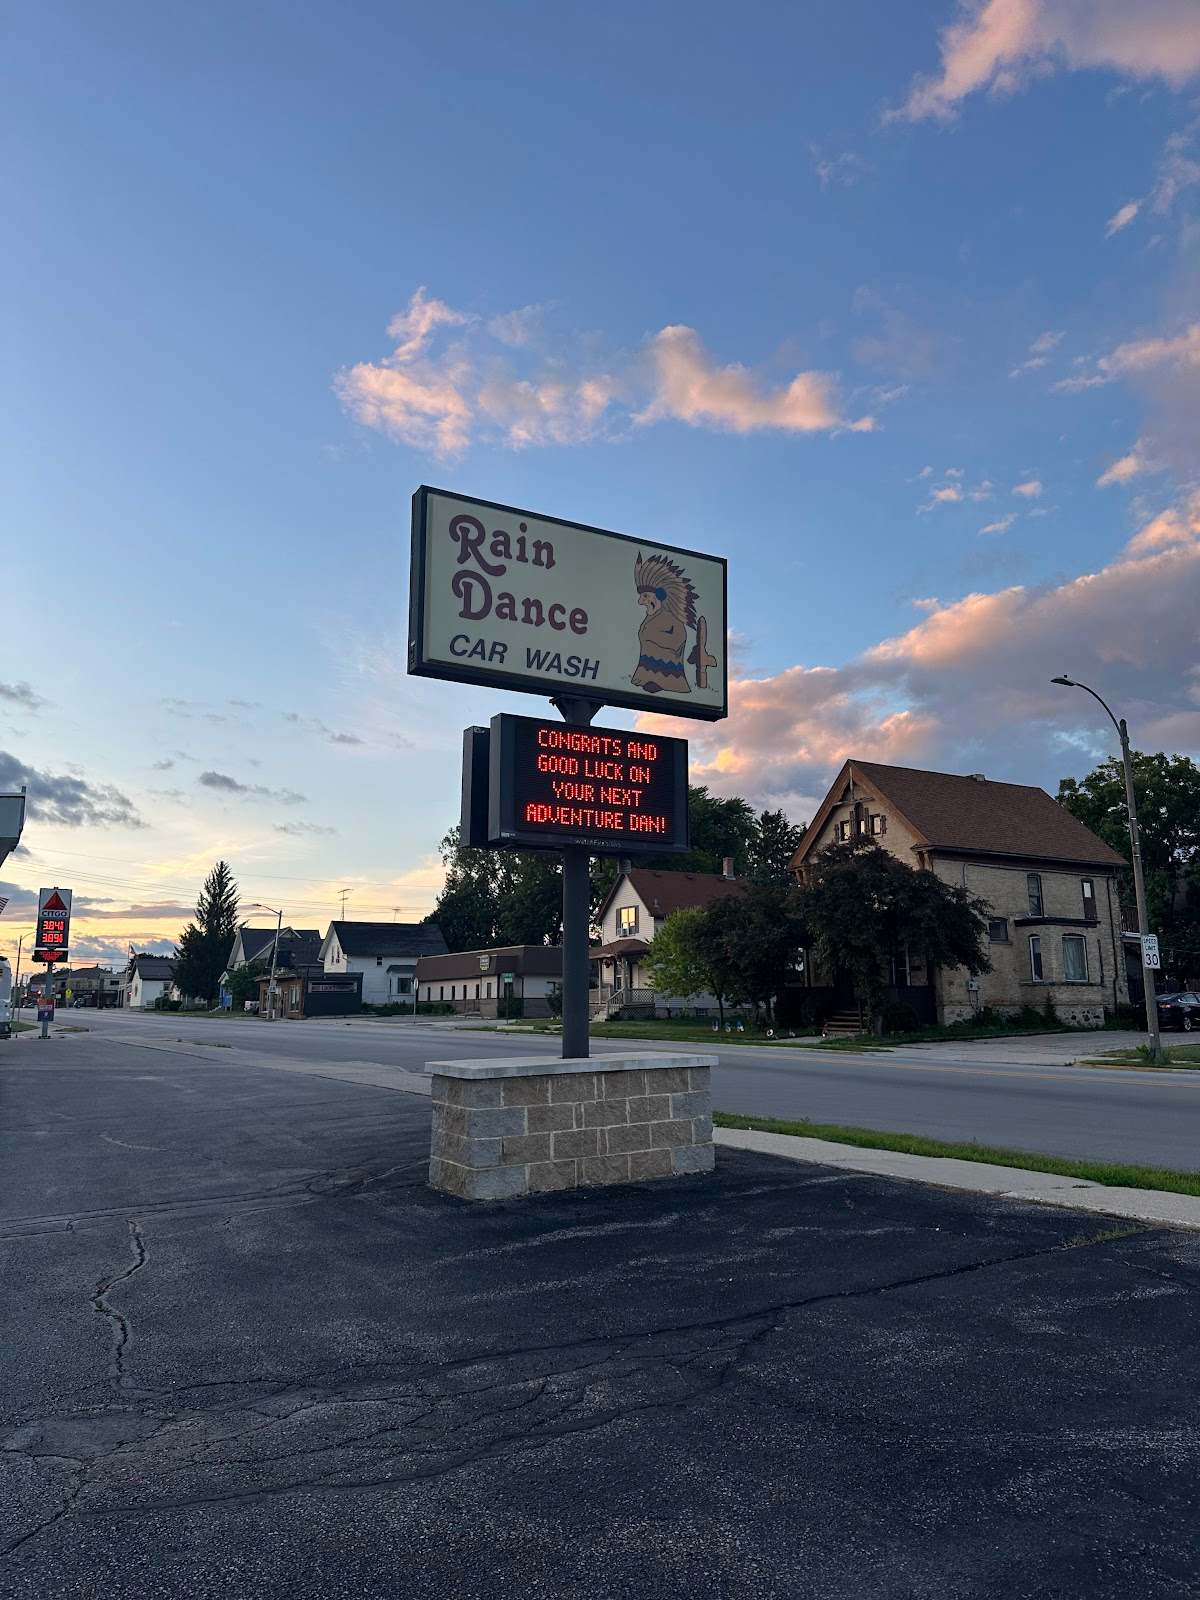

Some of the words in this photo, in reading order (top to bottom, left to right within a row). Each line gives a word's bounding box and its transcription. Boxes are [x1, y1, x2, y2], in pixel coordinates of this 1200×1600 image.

[449, 514, 556, 577] Rain
[452, 570, 589, 635] Dance
[450, 634, 508, 664] CAR
[526, 648, 600, 680] WASH
[538, 730, 621, 756] CONGRATS
[627, 742, 657, 761] AND
[538, 755, 579, 775] GOOD
[585, 760, 623, 781] LUCK
[629, 766, 650, 784] ON
[552, 781, 594, 802] YOUR
[600, 787, 642, 807] NEXT
[526, 803, 623, 829] ADVENTURE
[629, 814, 665, 833] DAN!
[1146, 953, 1158, 966] 30
